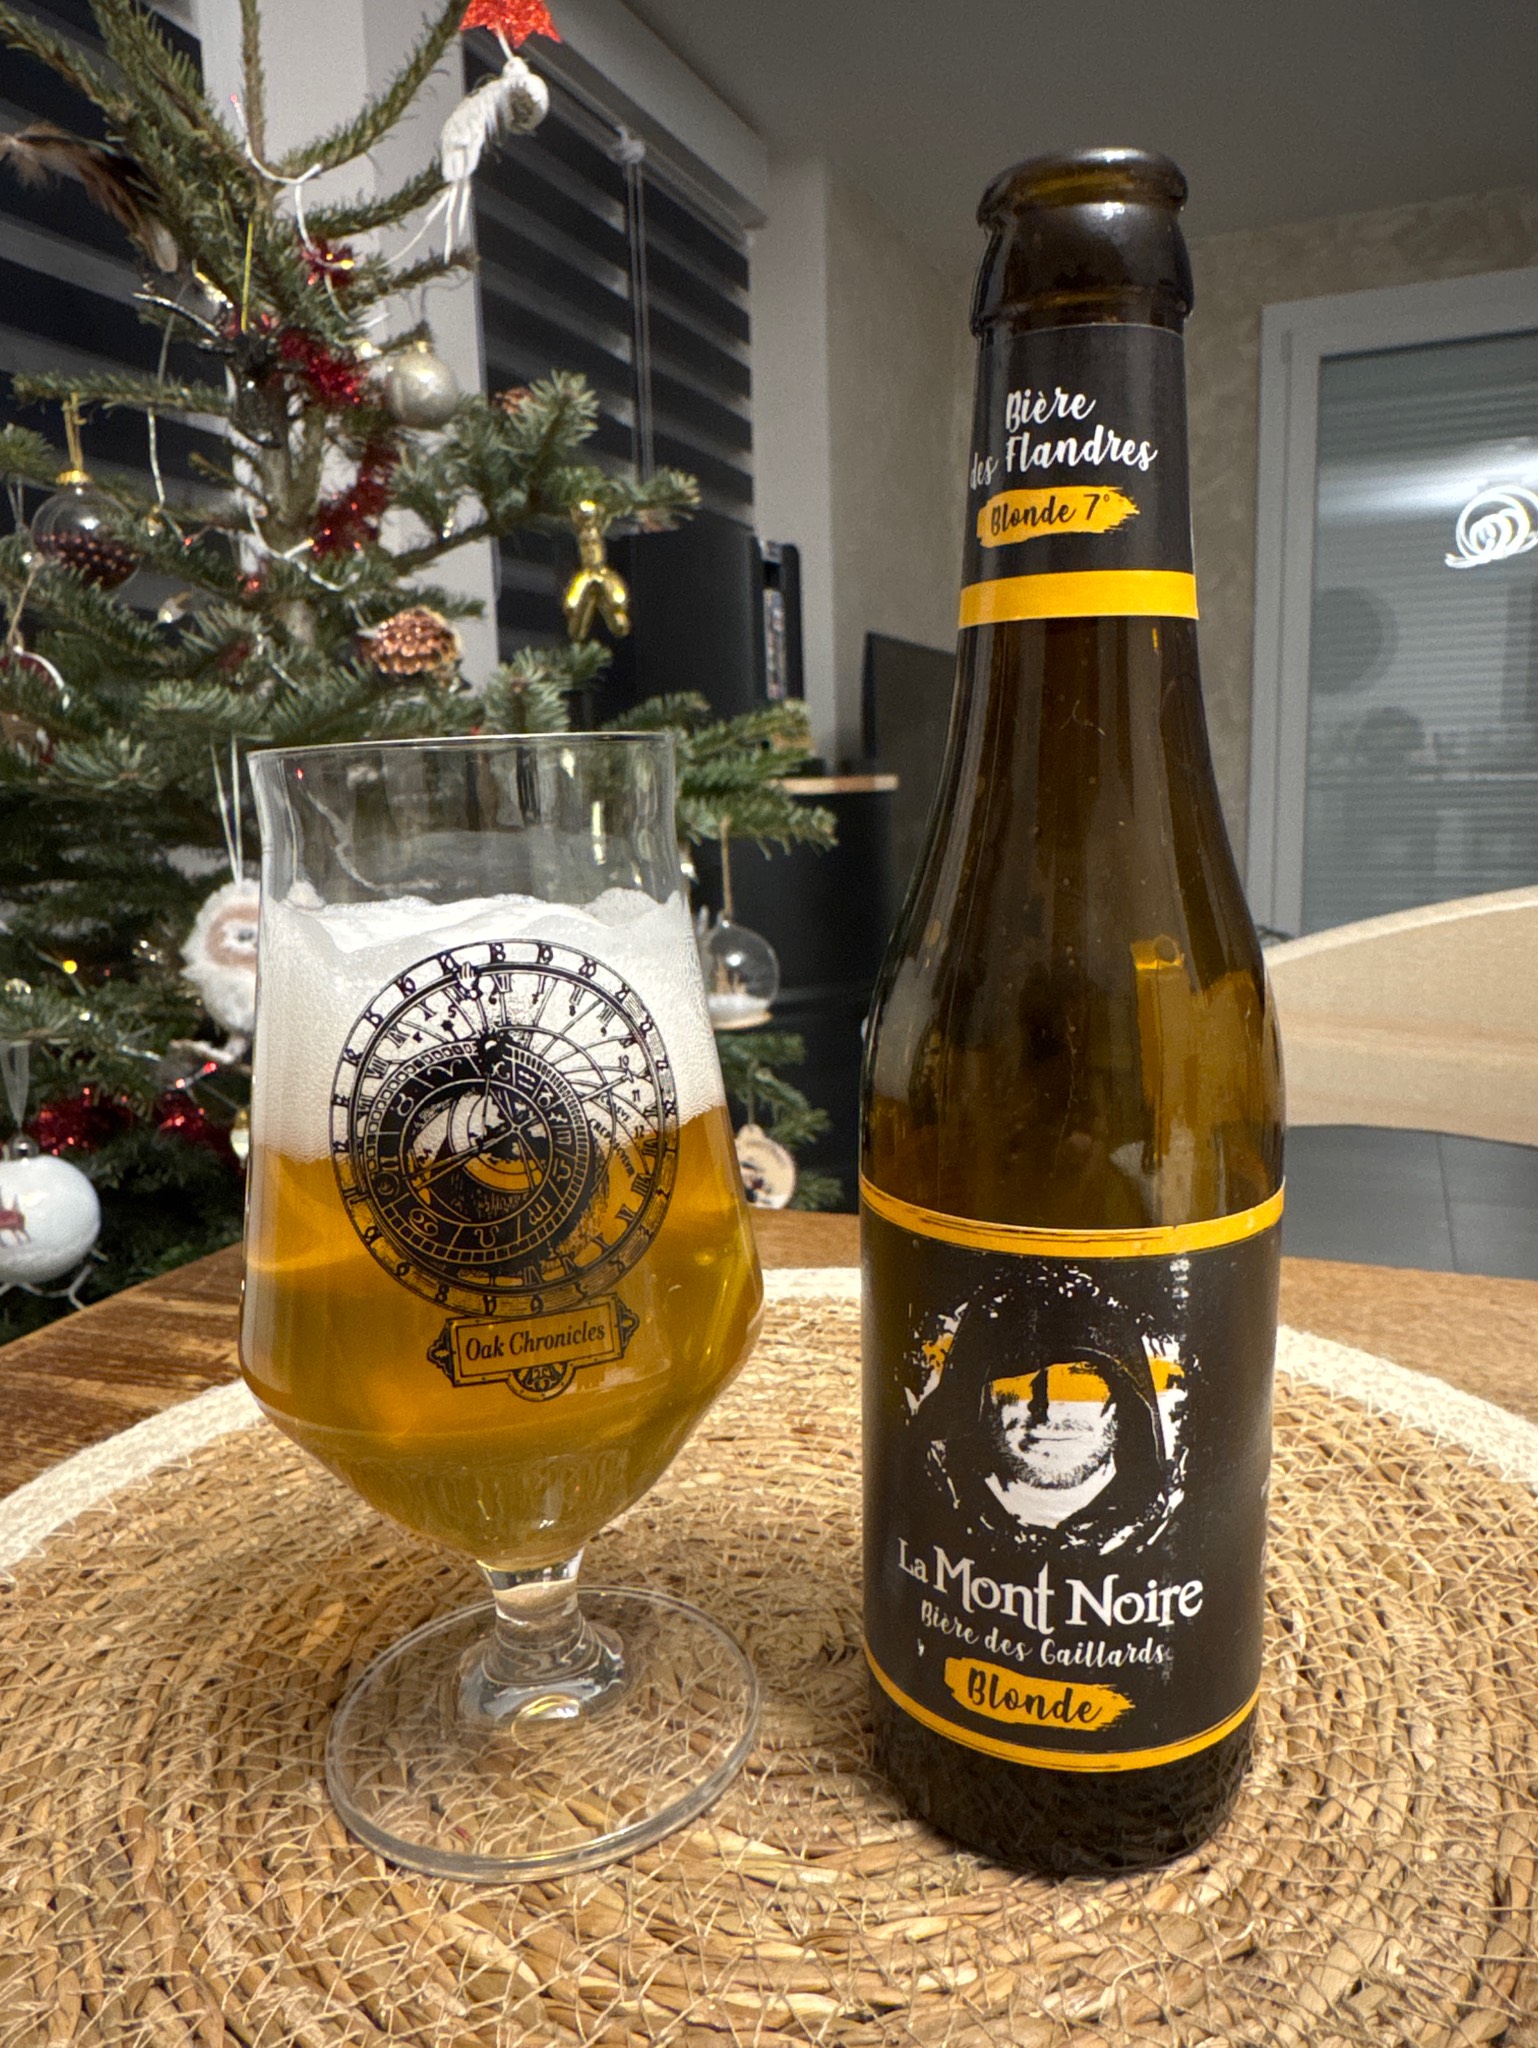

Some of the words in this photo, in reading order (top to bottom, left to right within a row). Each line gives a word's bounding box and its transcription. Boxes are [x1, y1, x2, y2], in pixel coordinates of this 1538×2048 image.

[1005, 386, 1096, 434] Bière
[969, 452, 998, 490] des
[1006, 424, 1158, 472] Flandres
[990, 495, 1076, 536] Blonde
[1083, 493, 1110, 521] 7°
[465, 1335, 504, 1361] Oak
[509, 1321, 605, 1356] Chronicles
[897, 1537, 928, 1584] La
[933, 1546, 1055, 1634] Mont
[1065, 1574, 1204, 1628] Noire
[920, 1600, 980, 1645] Bière
[985, 1630, 1033, 1662] des
[1040, 1637, 1166, 1668] Gaillards
[967, 1666, 1102, 1724] Blonde
